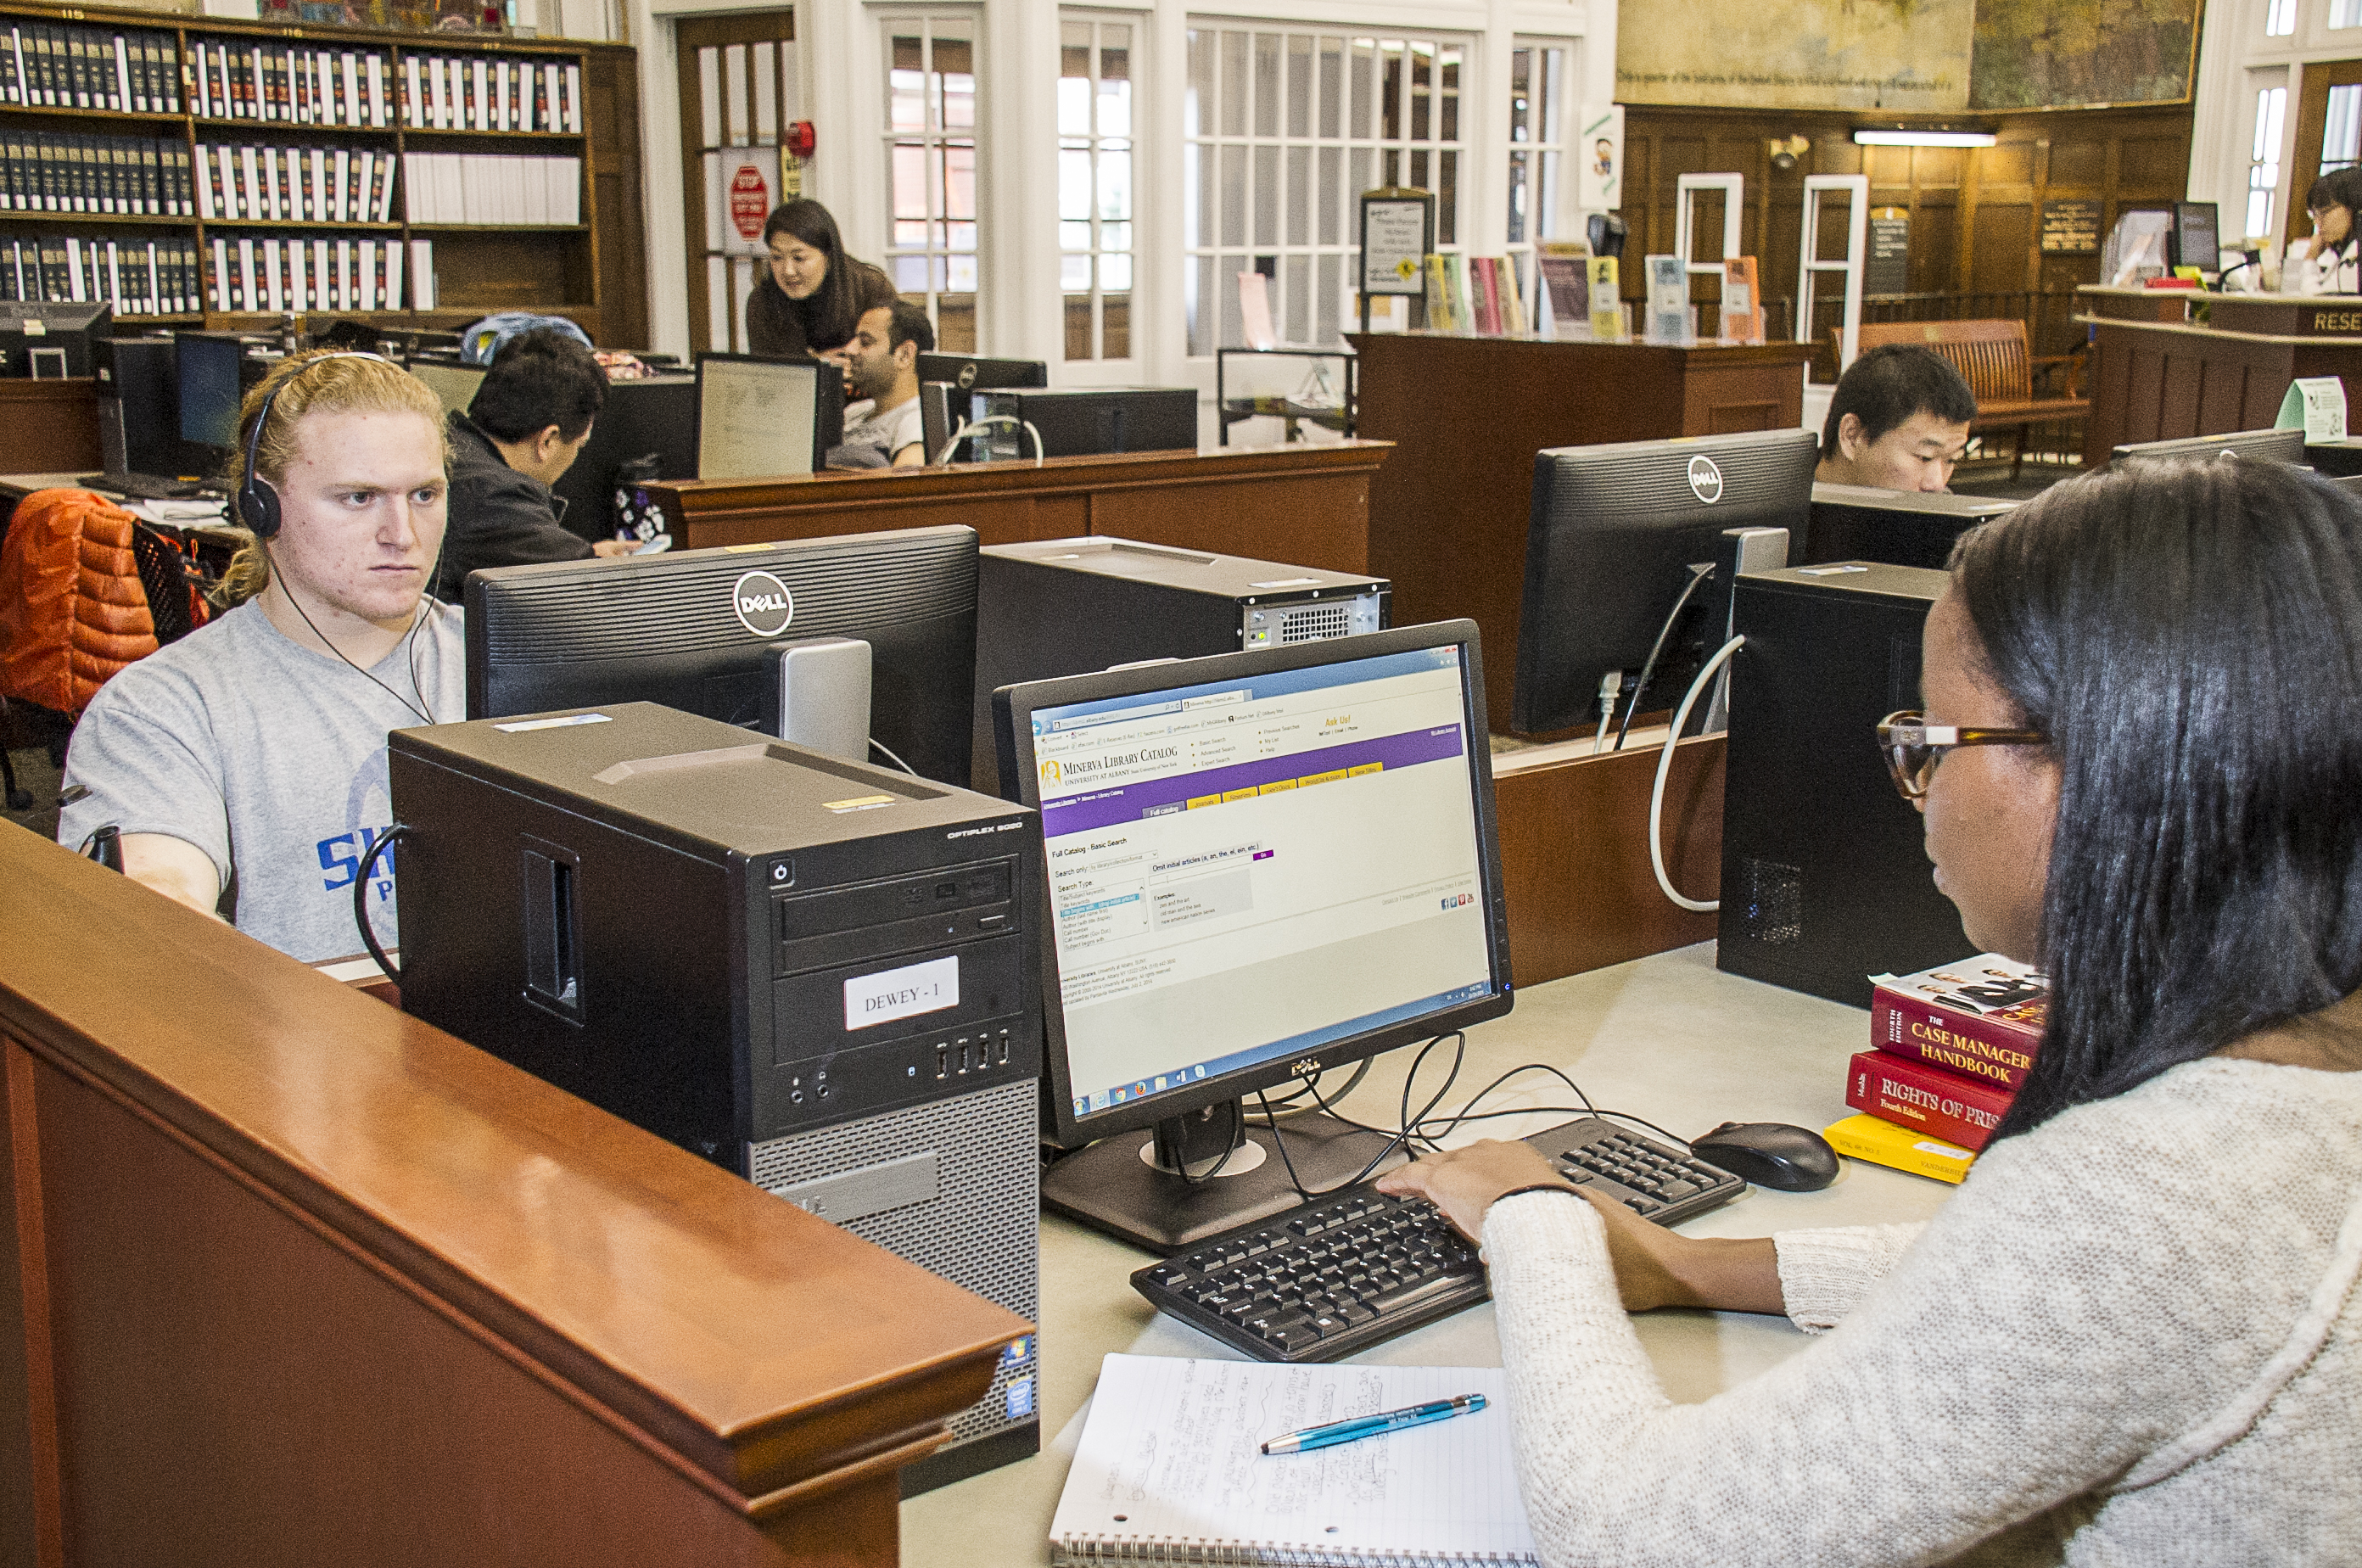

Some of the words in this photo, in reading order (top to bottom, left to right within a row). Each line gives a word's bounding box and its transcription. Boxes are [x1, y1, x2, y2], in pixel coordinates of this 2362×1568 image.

[1692, 472, 1718, 486] DELL
[740, 593, 787, 613] DELL
[1281, 723, 1300, 731] Searches
[1324, 716, 1337, 727] Ask
[1339, 714, 1351, 724] Us!
[1211, 736, 1226, 744] Search
[1200, 748, 1220, 756] Advanced
[1063, 757, 1101, 776] MINERVA
[1104, 750, 1139, 768] LIBRARY
[1139, 743, 1177, 762] CATALOG
[1065, 774, 1099, 786] UNIVERSITY
[1108, 768, 1129, 778] ALBANY
[1150, 808, 1161, 816] Full
[1161, 804, 1178, 815] catalog
[1051, 849, 1062, 858] Full
[1063, 844, 1086, 857] Catalog
[1090, 841, 1105, 849] Basic
[1107, 837, 1127, 846] Search
[1152, 862, 1166, 871] Omit
[1167, 860, 1180, 868] initial
[1181, 855, 1200, 865] articles
[1055, 867, 1075, 877] Search
[1076, 864, 1089, 875] only:
[1057, 882, 1077, 892] Search
[1077, 878, 1094, 888] Type:
[1170, 914, 1189, 922] american
[1065, 941, 1080, 951] Subject
[865, 986, 921, 1012] DEWEY
[1928, 1016, 1944, 1026] THE
[1911, 1022, 1951, 1045] CASE
[1921, 1044, 2012, 1084] HANDBOOK
[1881, 1078, 1939, 1111] RIGHTS
[1941, 1099, 1963, 1118] OF
[1880, 1099, 1902, 1114] Fourth
[1902, 1106, 1927, 1123] Edition
